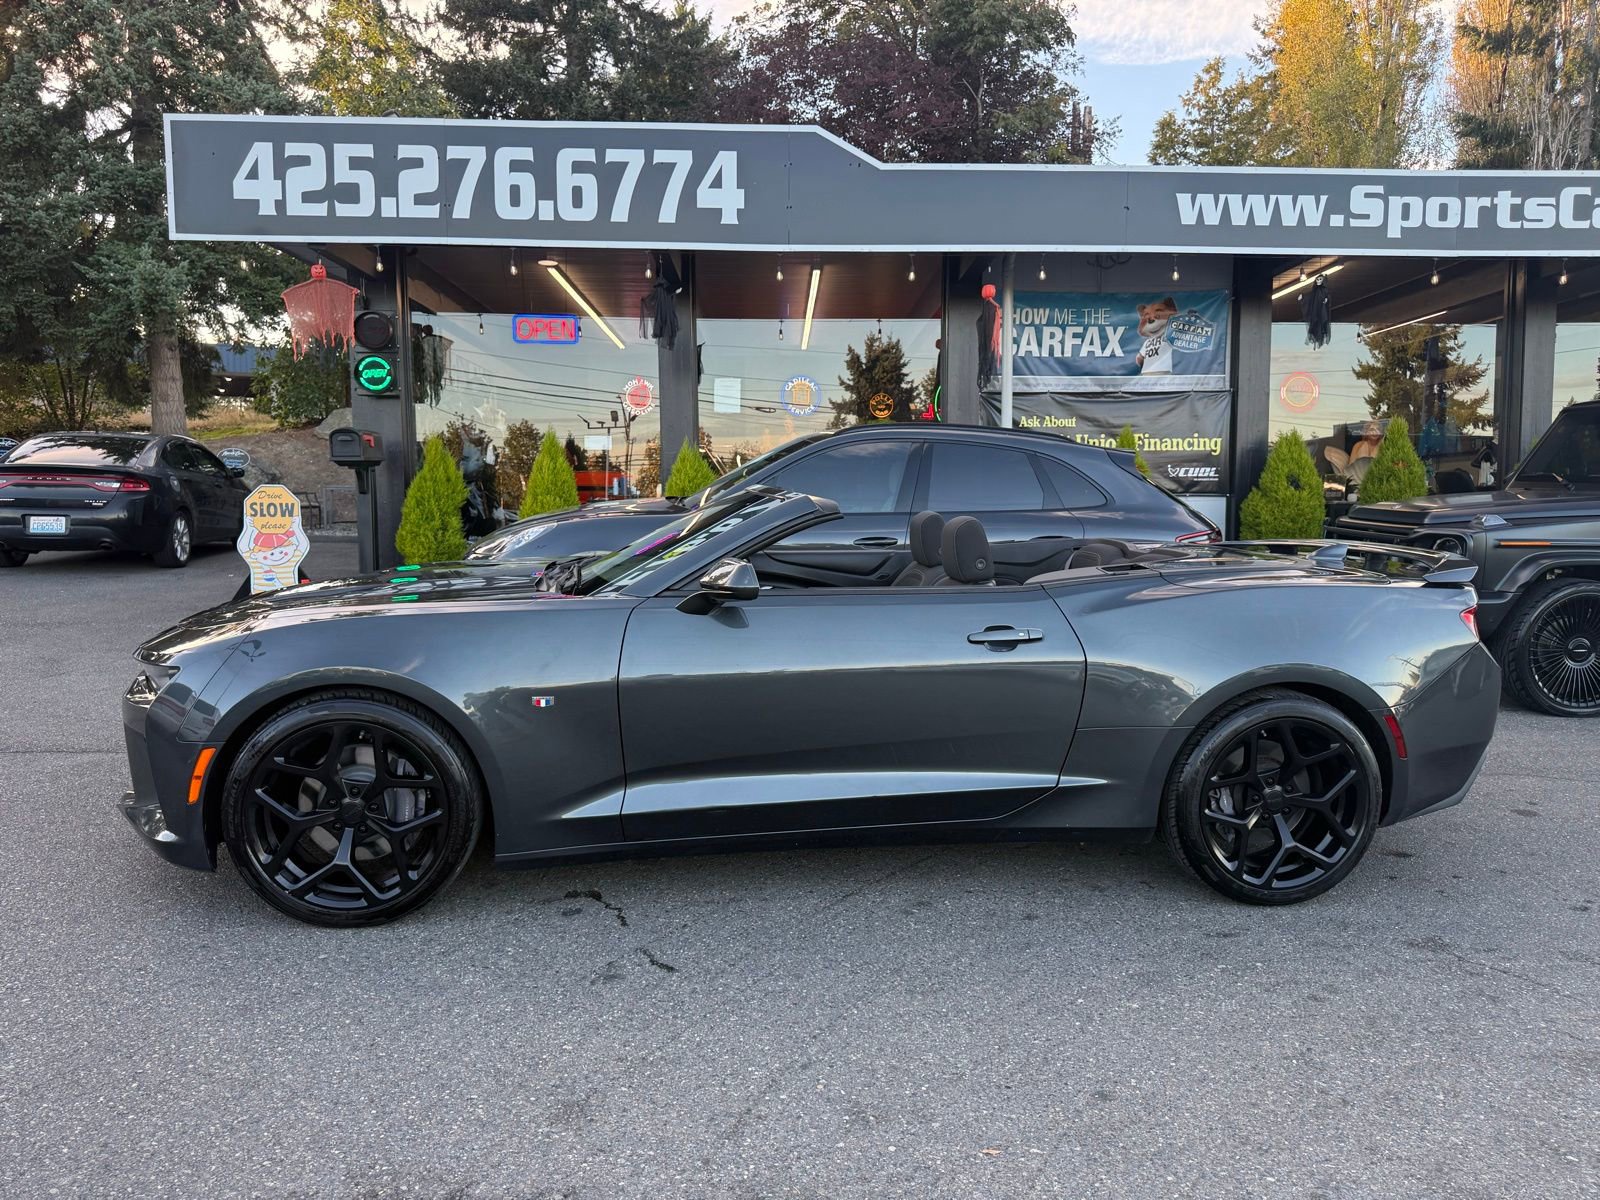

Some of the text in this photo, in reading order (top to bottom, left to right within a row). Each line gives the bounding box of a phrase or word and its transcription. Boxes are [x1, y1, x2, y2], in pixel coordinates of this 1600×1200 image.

[232, 141, 745, 225] 425.276.6774
[1175, 184, 1600, 239] www.SportsC
[1000, 308, 1110, 325] HOW ME THE
[516, 318, 576, 340] OPEN
[1171, 320, 1211, 336] CARFAX
[1170, 331, 1207, 344] ADVANTAGE
[1173, 339, 1199, 349] DEALER
[362, 368, 388, 378] OPEN
[785, 377, 818, 392] CADILLAC
[788, 404, 816, 415] SERVICE
[1019, 415, 1077, 428] Ask About
[1075, 432, 1222, 455] Unio Financing
[257, 490, 283, 500] Drive
[249, 502, 295, 518] SLOW
[260, 520, 287, 531] please
